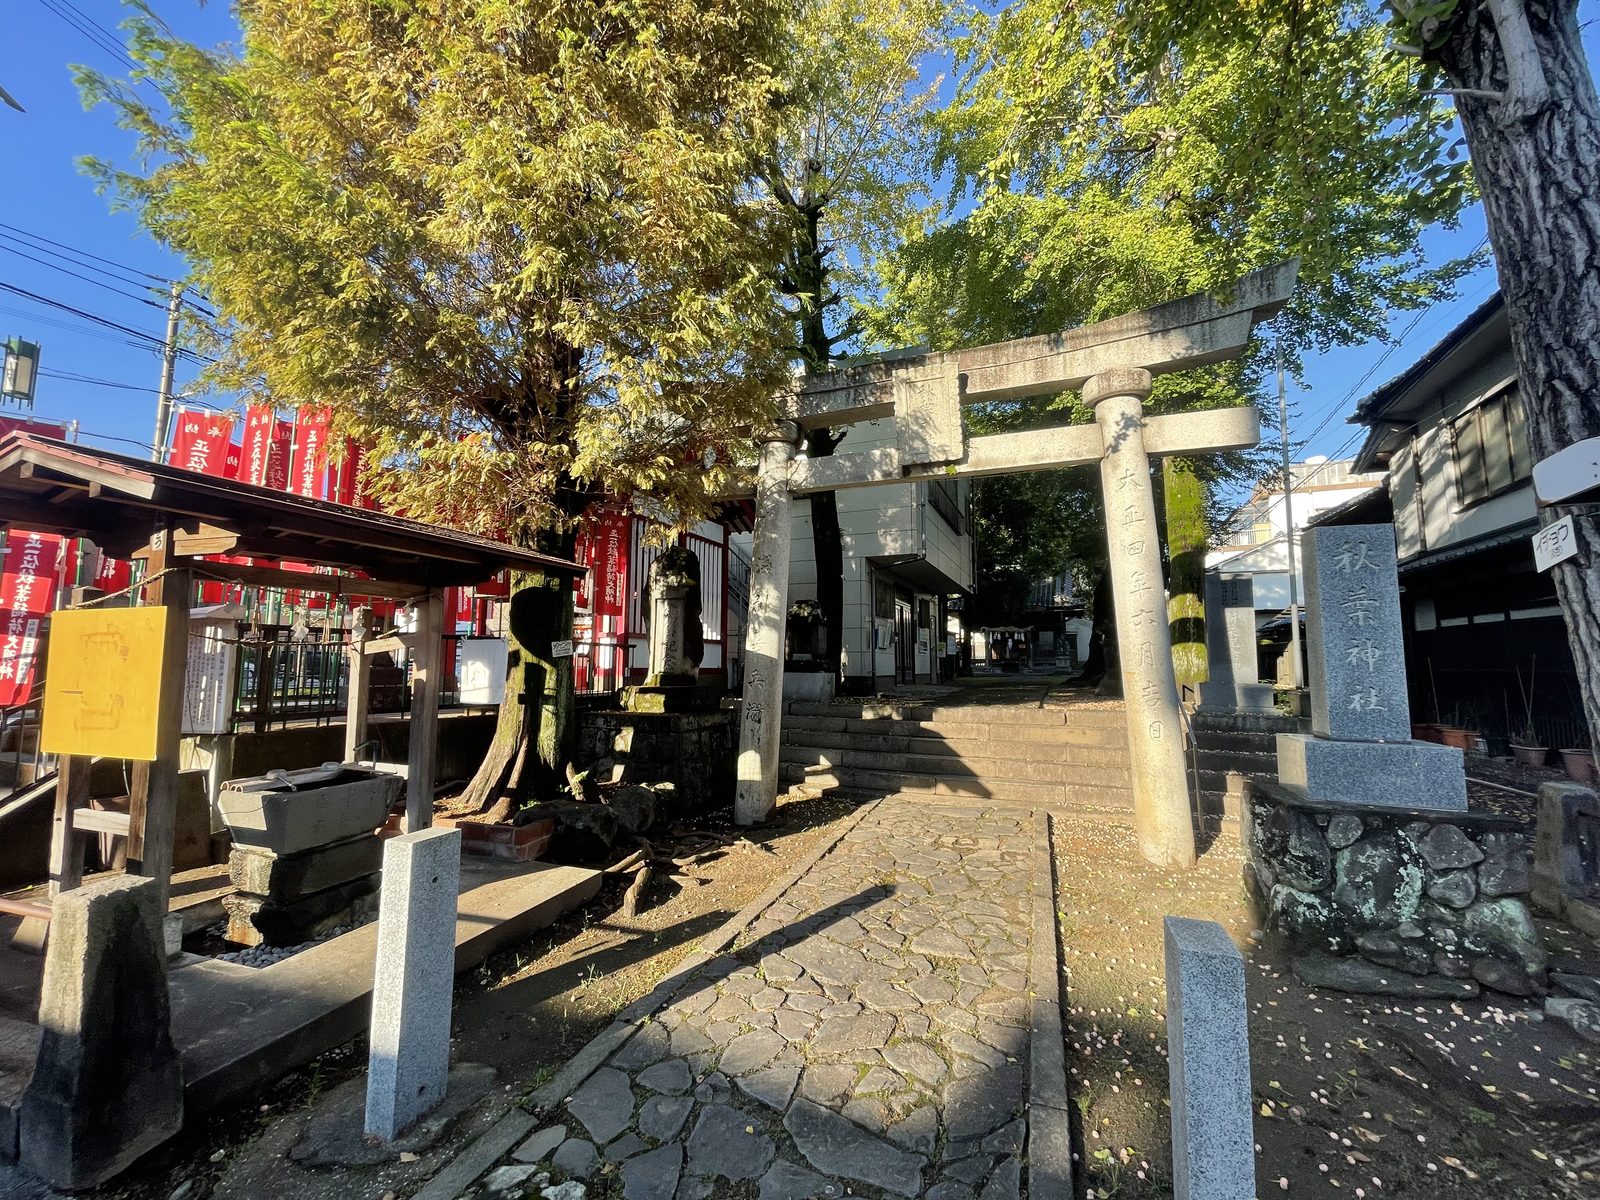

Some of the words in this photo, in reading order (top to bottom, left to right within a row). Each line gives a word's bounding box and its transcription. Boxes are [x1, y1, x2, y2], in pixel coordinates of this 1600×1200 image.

[1119, 468, 1163, 740] 大正四年六月吉日
[1333, 541, 1388, 711] 秋葉神社
